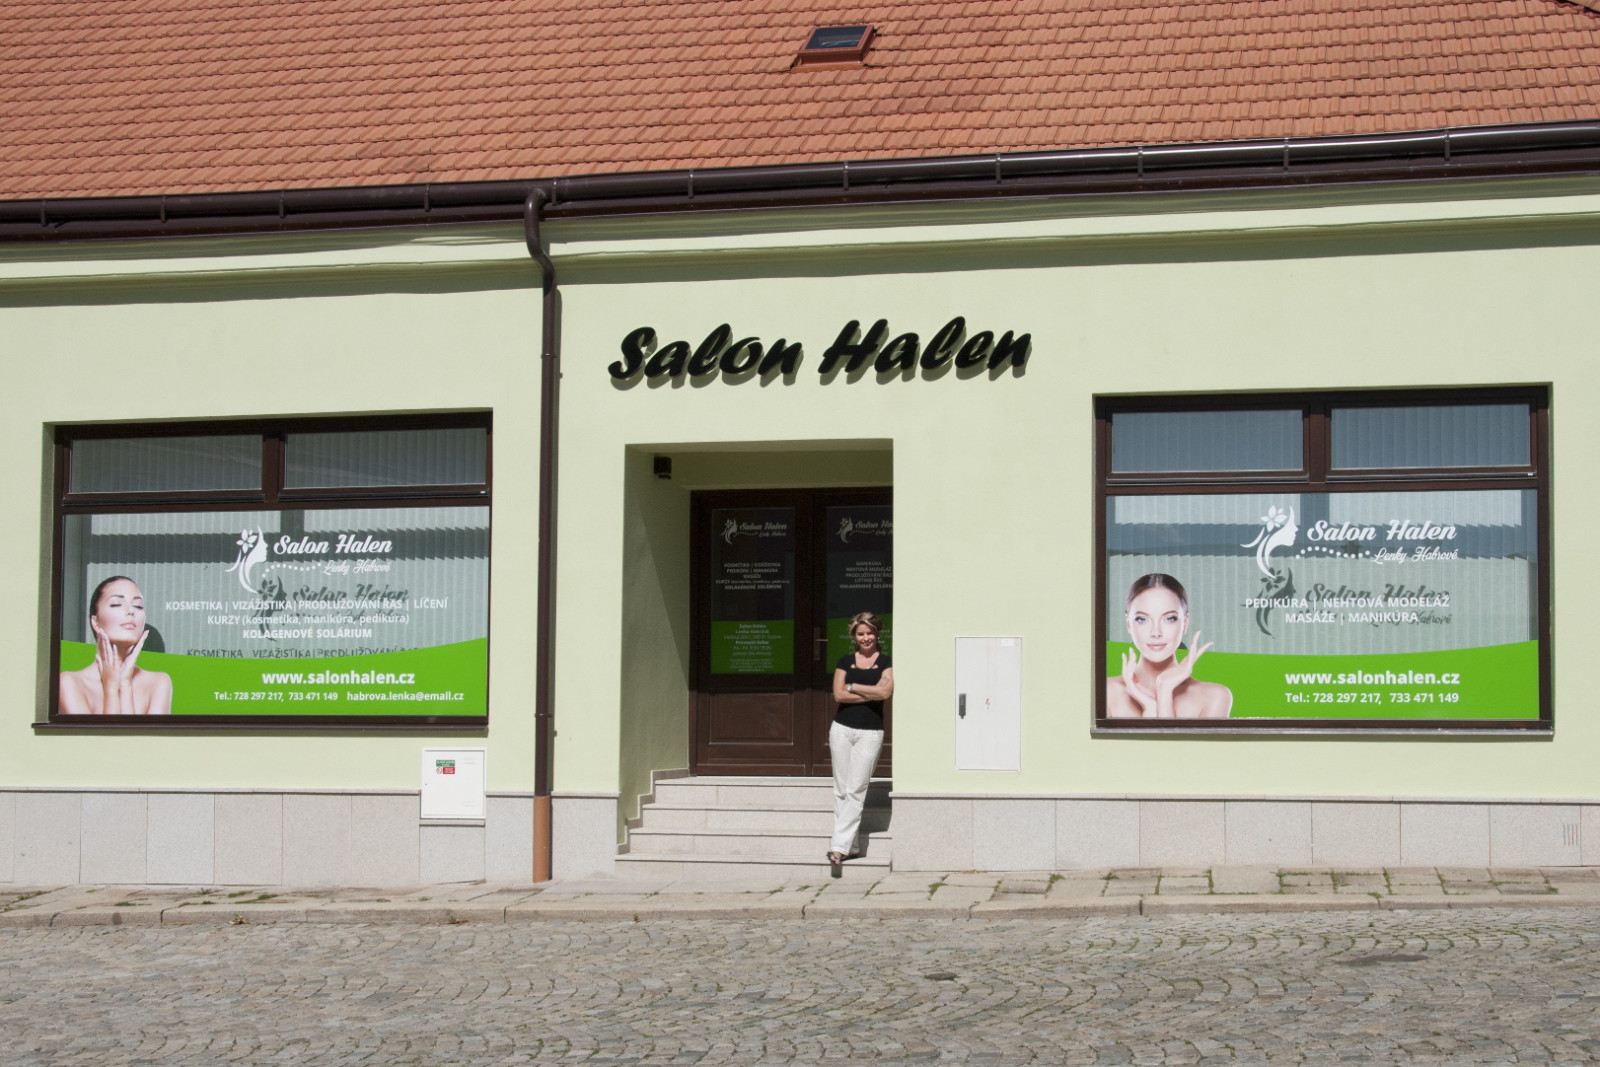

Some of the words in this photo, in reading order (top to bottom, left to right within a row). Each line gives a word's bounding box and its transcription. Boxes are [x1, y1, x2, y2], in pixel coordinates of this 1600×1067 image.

[608, 323, 802, 379] Salon
[818, 316, 1031, 375] Halen
[1307, 520, 1376, 541] Salon
[1386, 519, 1457, 541] Halen
[273, 535, 330, 554] Salon
[335, 534, 393, 553] Halen
[1373, 547, 1408, 564] Lenky
[1411, 546, 1459, 562] Habrové
[165, 601, 223, 611] KOSMETIKA
[232, 598, 293, 610] VIZÁŽISTIKA
[299, 597, 381, 609] PRODLUŽOVÁNÍ
[383, 597, 403, 609] ŘAS
[413, 597, 448, 608] LÍČENÍ
[1245, 595, 1308, 608] PEDIKÚRA
[1323, 595, 1383, 608] NEHTOVÁ
[1388, 594, 1450, 608] MODELÁŽ
[207, 615, 240, 625] KURZY
[242, 614, 301, 626] (kosmetika,
[304, 613, 356, 625] manikúra,
[359, 613, 410, 626] pedikúra)
[1285, 609, 1336, 623] MASÁŽE
[1348, 609, 1419, 623] MANIKÚRA
[242, 627, 313, 639] KOLAGENOVÉ
[316, 627, 372, 638] SOLÁRIUM
[261, 670, 415, 685] www.salonhalen.cz
[1285, 670, 1460, 685] www.salonhalen.cz
[214, 691, 232, 700] Tel.:
[234, 692, 249, 700] 728
[251, 692, 266, 700] 297
[267, 692, 284, 702] 217,
[289, 692, 304, 700] 733
[305, 692, 321, 700] 471
[323, 692, 338, 700] 149
[347, 691, 464, 701] habrova.lenka@email.cz
[1285, 692, 1310, 703] Tel.:
[1312, 692, 1334, 703] 728
[1336, 692, 1357, 703] 297
[1360, 692, 1382, 705] 217,
[1389, 692, 1411, 703] 733
[1413, 692, 1434, 703] 471
[1438, 692, 1459, 703] 149
